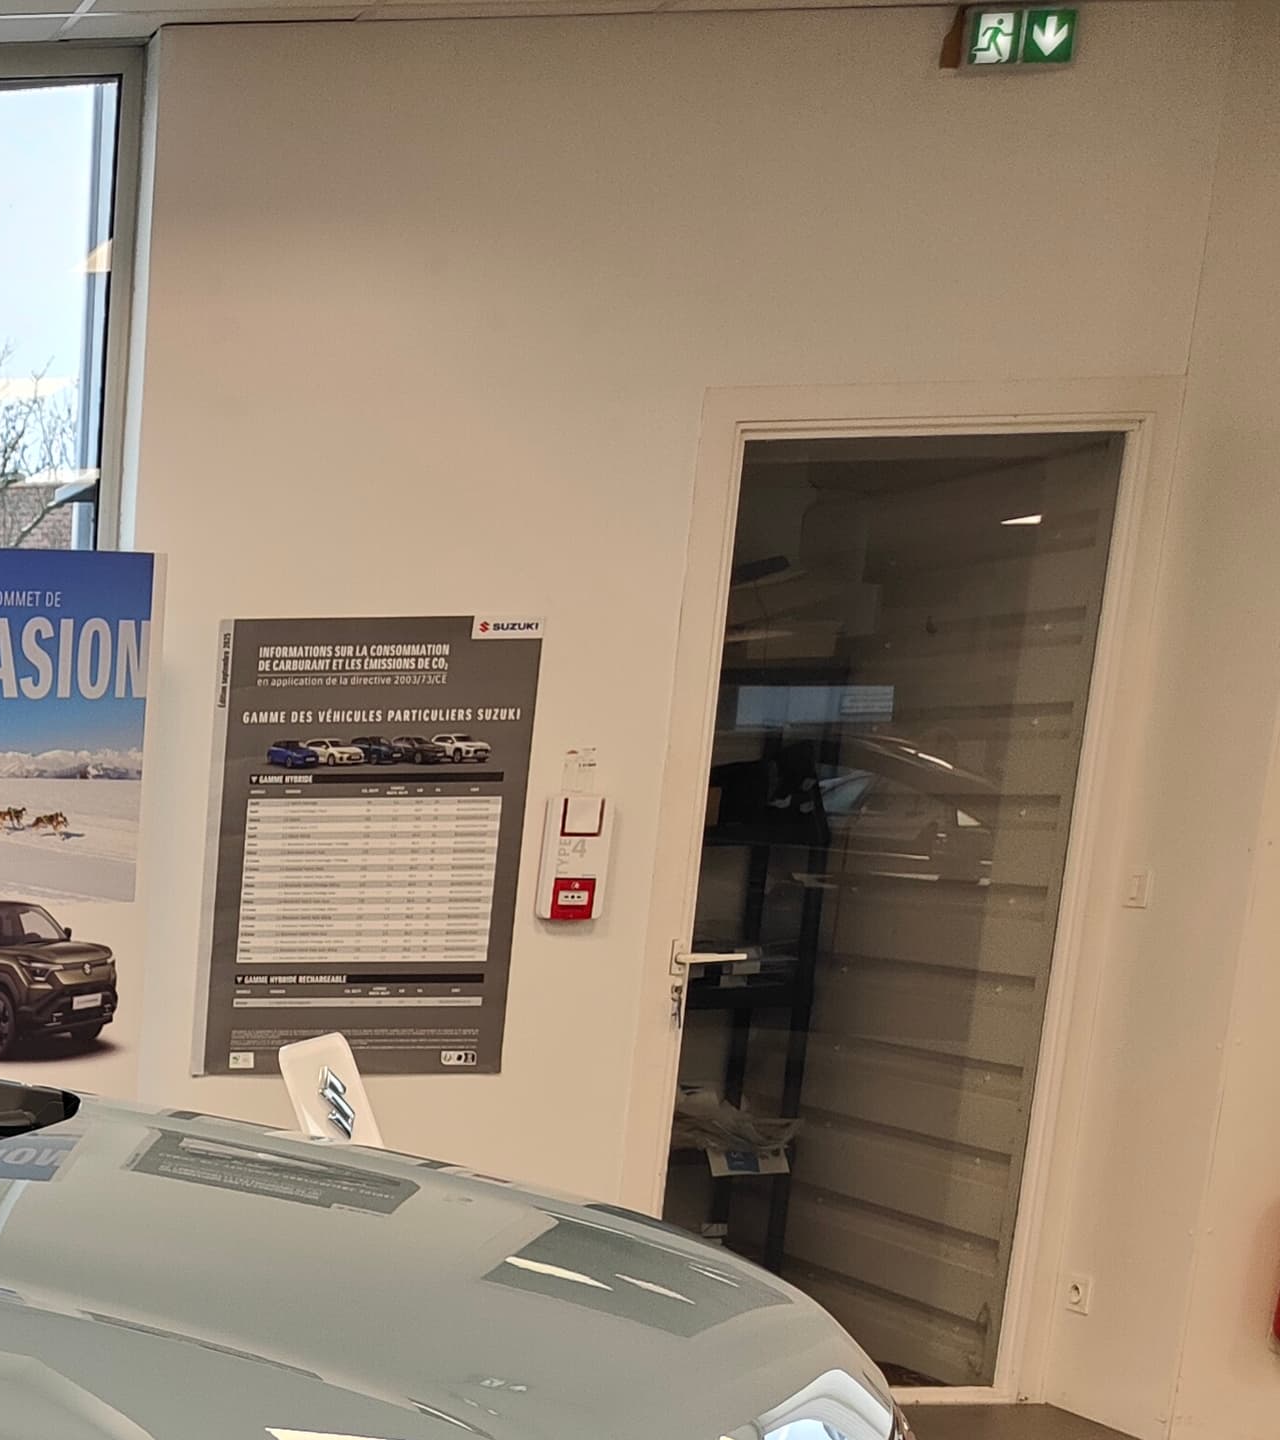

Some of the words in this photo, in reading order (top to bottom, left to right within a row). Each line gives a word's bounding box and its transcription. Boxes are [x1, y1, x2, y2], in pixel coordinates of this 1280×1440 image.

[45, 592, 62, 608] DE
[492, 621, 540, 632] SUZUKI
[259, 645, 333, 658] INFORMATIONS
[334, 645, 354, 657] SUR
[355, 645, 368, 657] LA
[370, 643, 450, 656] CONSOMMATION
[258, 659, 271, 671] DE
[272, 659, 331, 671] CARBURANT
[332, 659, 344, 670] ET
[345, 658, 362, 670] LES
[363, 655, 416, 670] ÉMISSIONS
[417, 657, 431, 669] DE
[257, 678, 269, 687] en
[270, 676, 323, 687] application
[325, 676, 337, 686] de
[339, 675, 348, 686] la
[350, 675, 391, 686] directive
[394, 674, 447, 685] 2003/73/CE
[243, 711, 286, 724] GAMME
[290, 711, 313, 723] DES
[318, 708, 382, 722] VÉHICULES
[387, 708, 472, 722] PARTICULIERS
[476, 708, 521, 721] SUZUKI
[259, 775, 283, 784] GAMME
[284, 774, 313, 784] HYBRIDE
[571, 838, 587, 858] 4
[244, 975, 267, 984] GAMME
[269, 975, 297, 984] HYBRIDE
[298, 974, 347, 984] RECHARGEABLE
